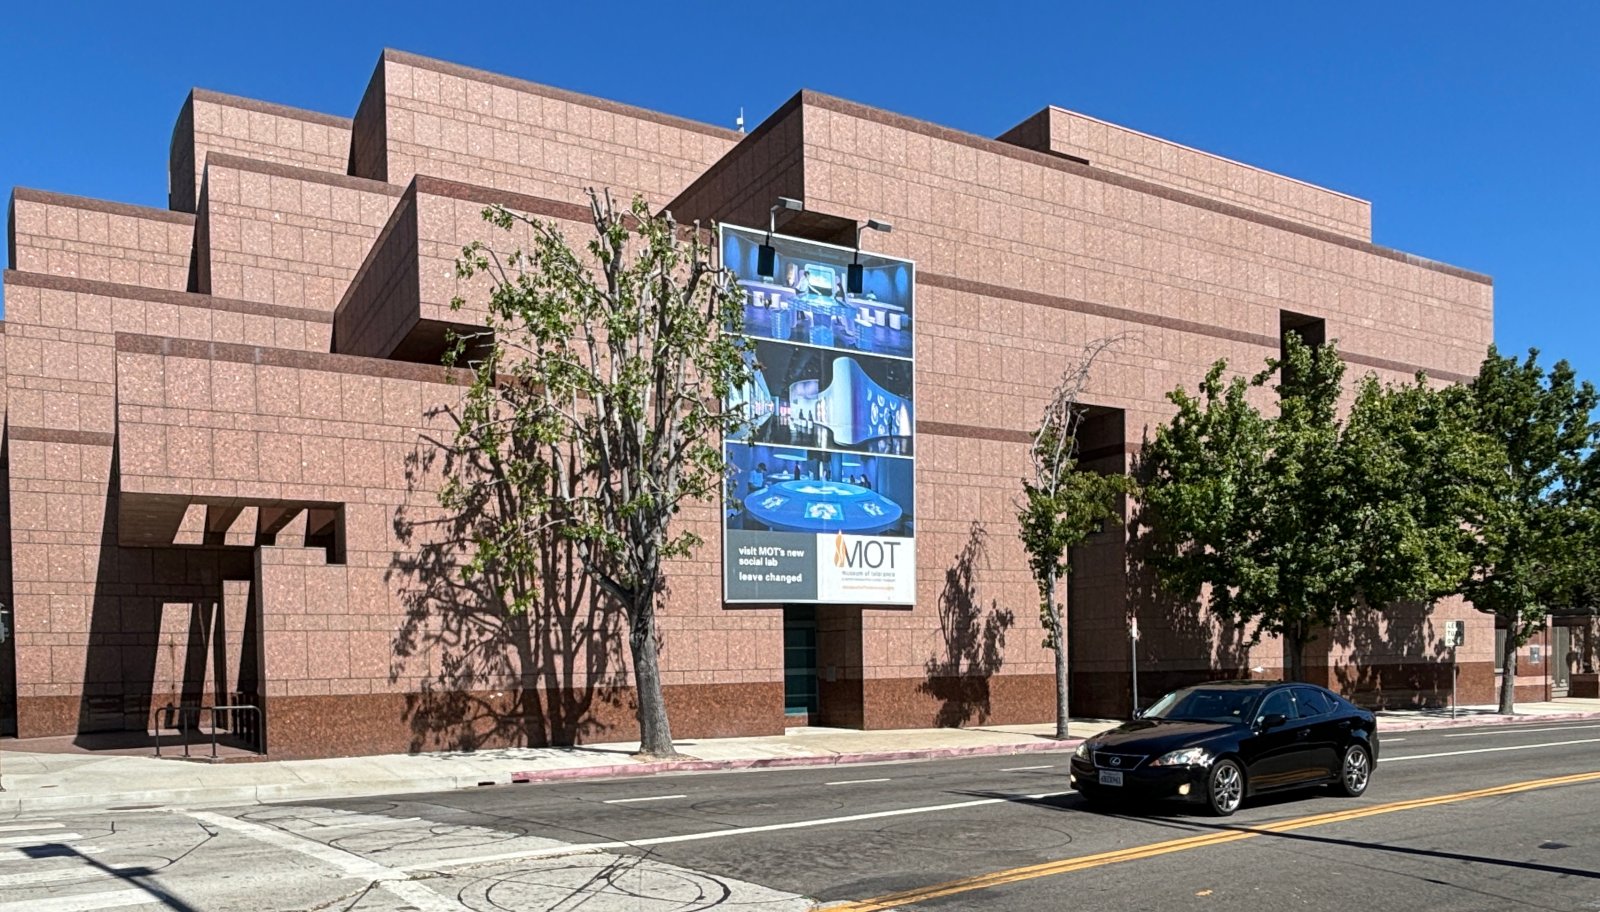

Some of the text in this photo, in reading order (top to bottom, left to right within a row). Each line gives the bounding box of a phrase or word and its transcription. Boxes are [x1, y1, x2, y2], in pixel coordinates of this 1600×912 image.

[738, 546, 805, 557] visit MOT's new
[835, 539, 902, 569] MOT
[738, 557, 778, 567] social lab
[738, 572, 803, 584] leave changed
